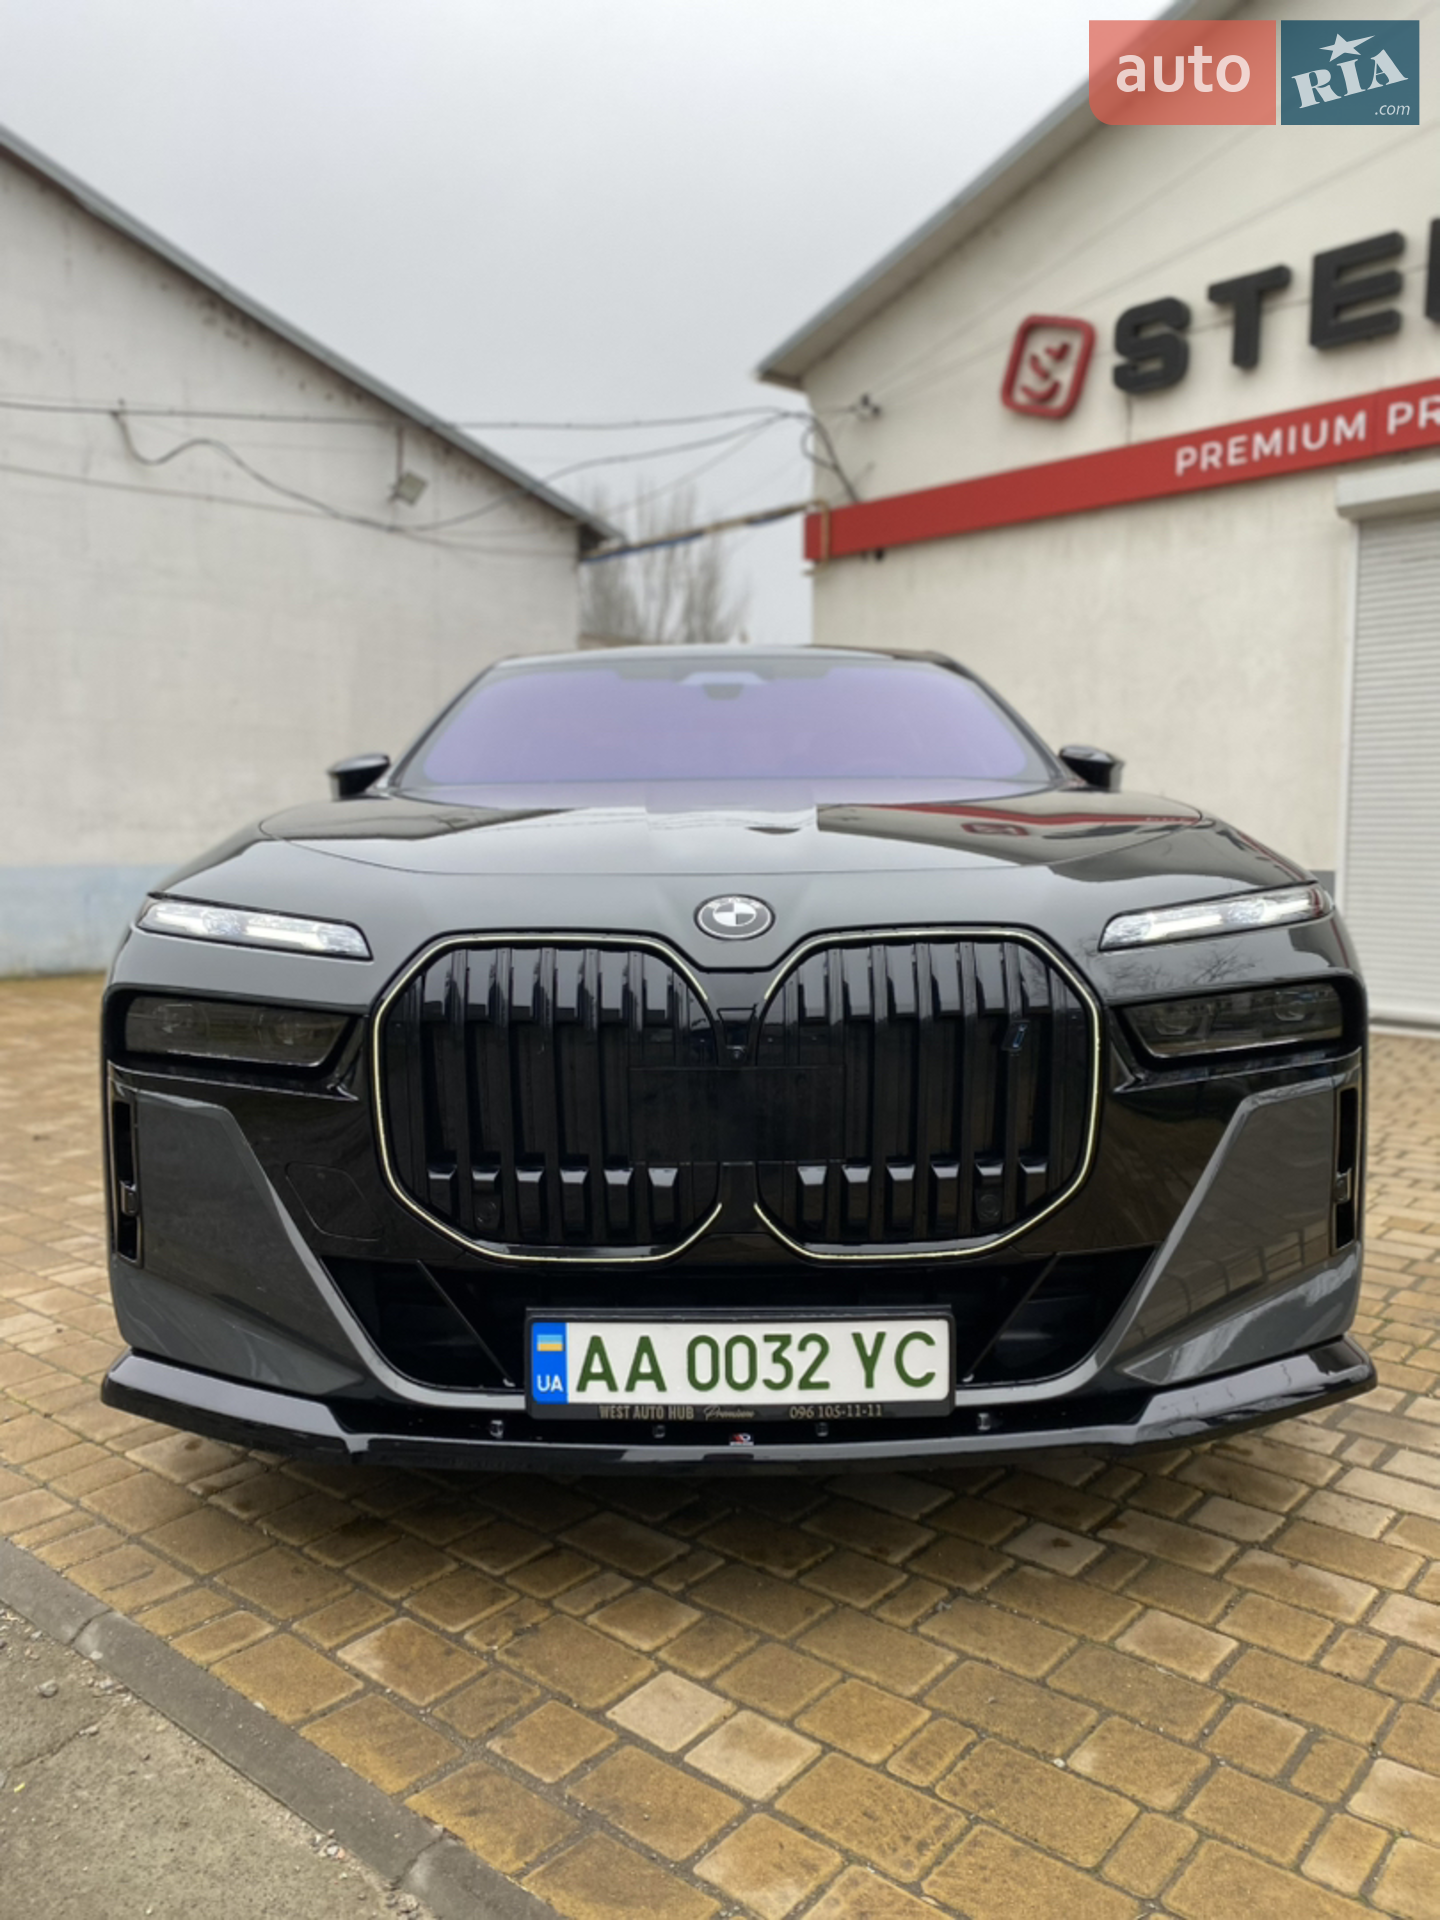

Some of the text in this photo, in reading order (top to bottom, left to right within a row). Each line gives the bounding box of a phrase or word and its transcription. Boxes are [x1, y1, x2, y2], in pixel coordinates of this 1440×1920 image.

[1174, 411, 1367, 476] PREMIUM
[576, 1331, 937, 1393] AA 0032 YC
[536, 1374, 564, 1393] UA
[599, 1405, 630, 1420] WEST
[633, 1405, 665, 1420] AUTO
[668, 1405, 694, 1420] HUB
[789, 1405, 815, 1419] 096
[818, 1403, 883, 1418] 105-11-11
